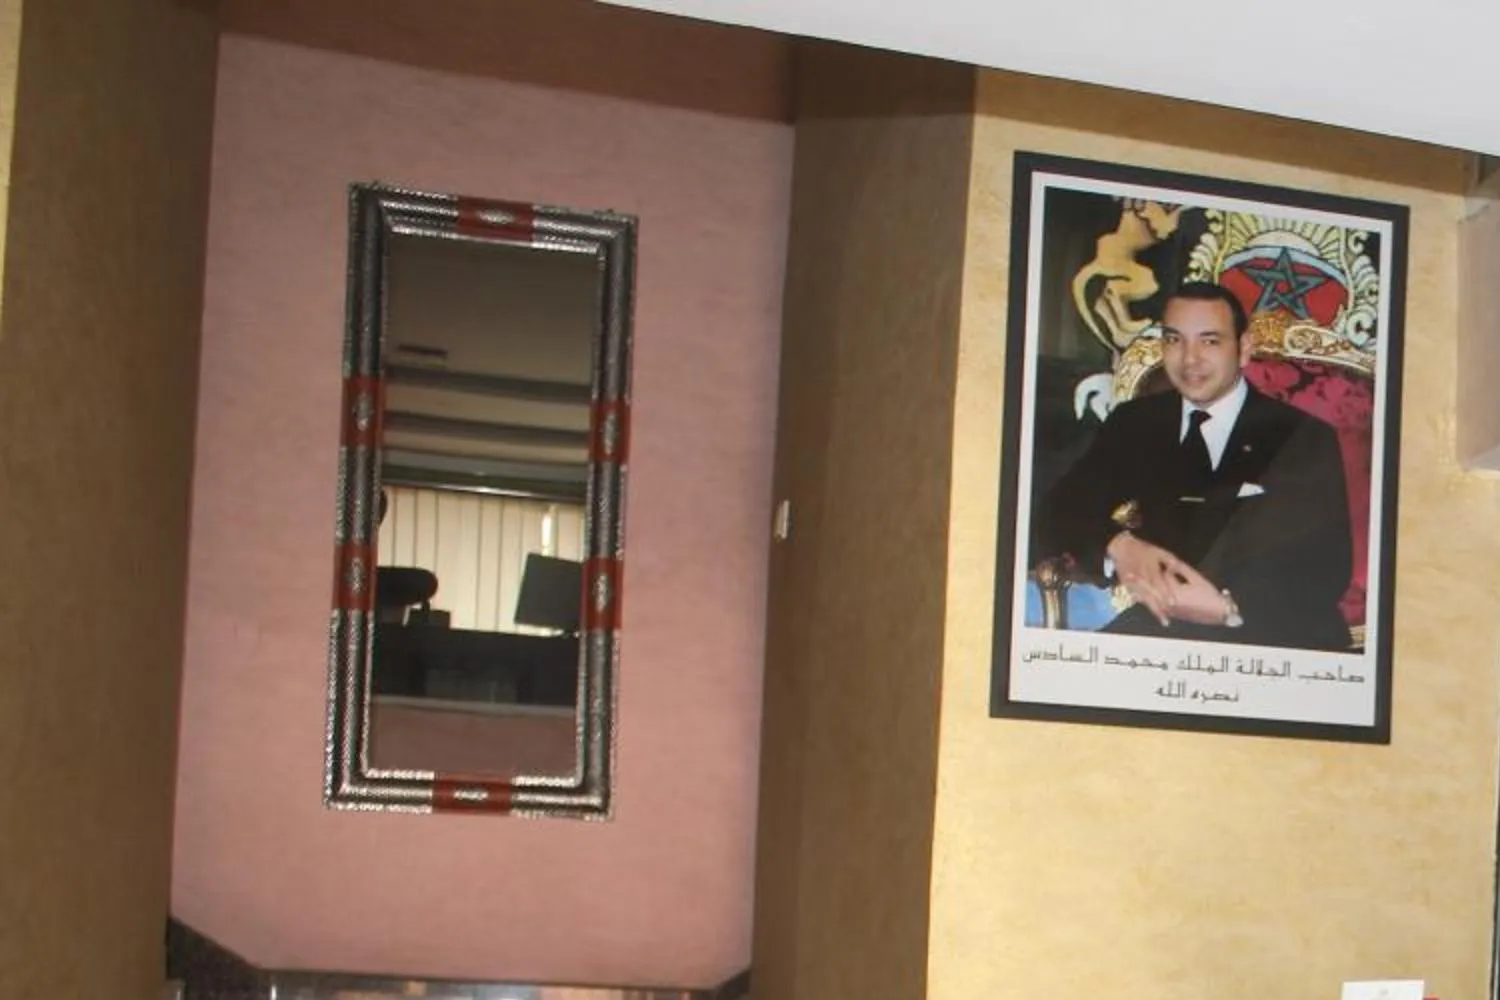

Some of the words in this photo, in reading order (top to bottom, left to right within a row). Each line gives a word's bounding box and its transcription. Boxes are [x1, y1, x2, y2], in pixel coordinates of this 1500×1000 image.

[1022, 643, 1099, 664] السادس
[1103, 655, 1169, 671] محمد
[1176, 653, 1229, 675] الملك
[1235, 657, 1292, 685] الجلالة
[1297, 664, 1365, 685] صاحب
[1155, 680, 1187, 699] الله
